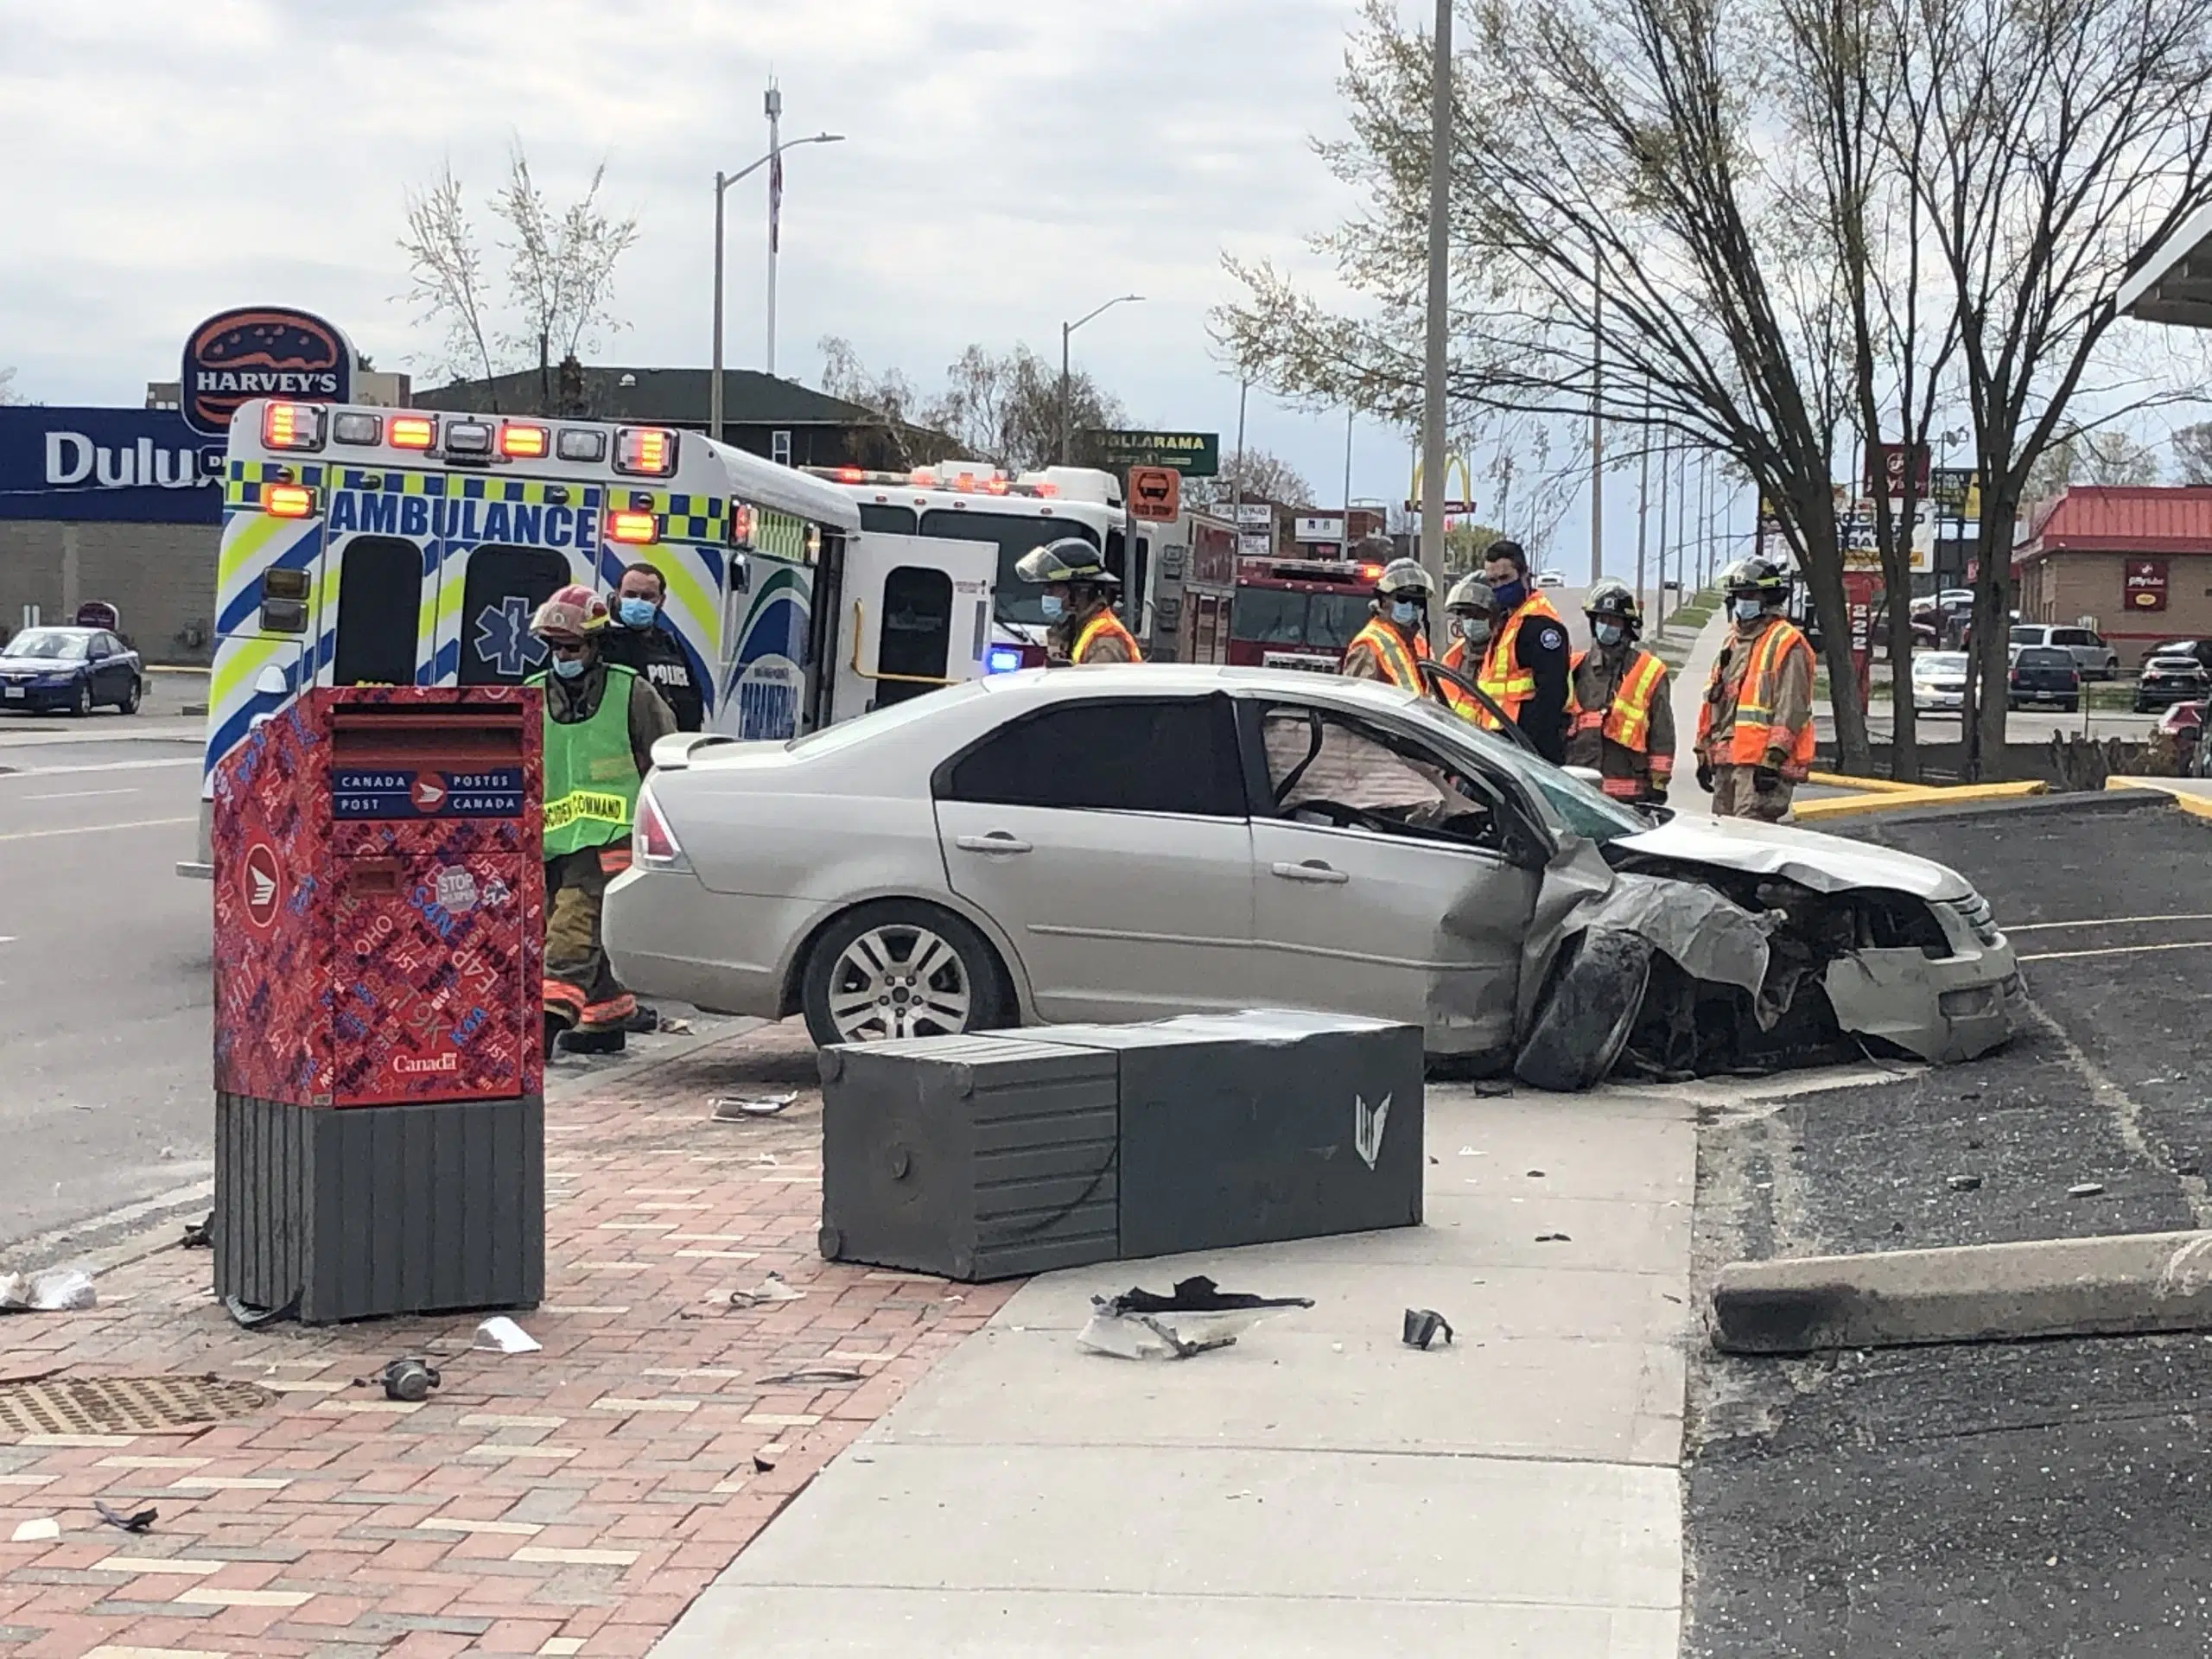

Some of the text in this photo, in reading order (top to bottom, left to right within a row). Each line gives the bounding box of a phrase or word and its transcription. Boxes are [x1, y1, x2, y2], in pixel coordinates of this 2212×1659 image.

[196, 372, 337, 392] HARVEY'S
[329, 491, 597, 549] AMBULANCE
[341, 776, 405, 787] CANADA
[454, 775, 509, 787] POSTES
[341, 799, 379, 810] POST
[454, 798, 515, 810] CANADA
[573, 794, 621, 820] COMMAND
[440, 873, 474, 892] STOP
[393, 1052, 457, 1073] Canada
